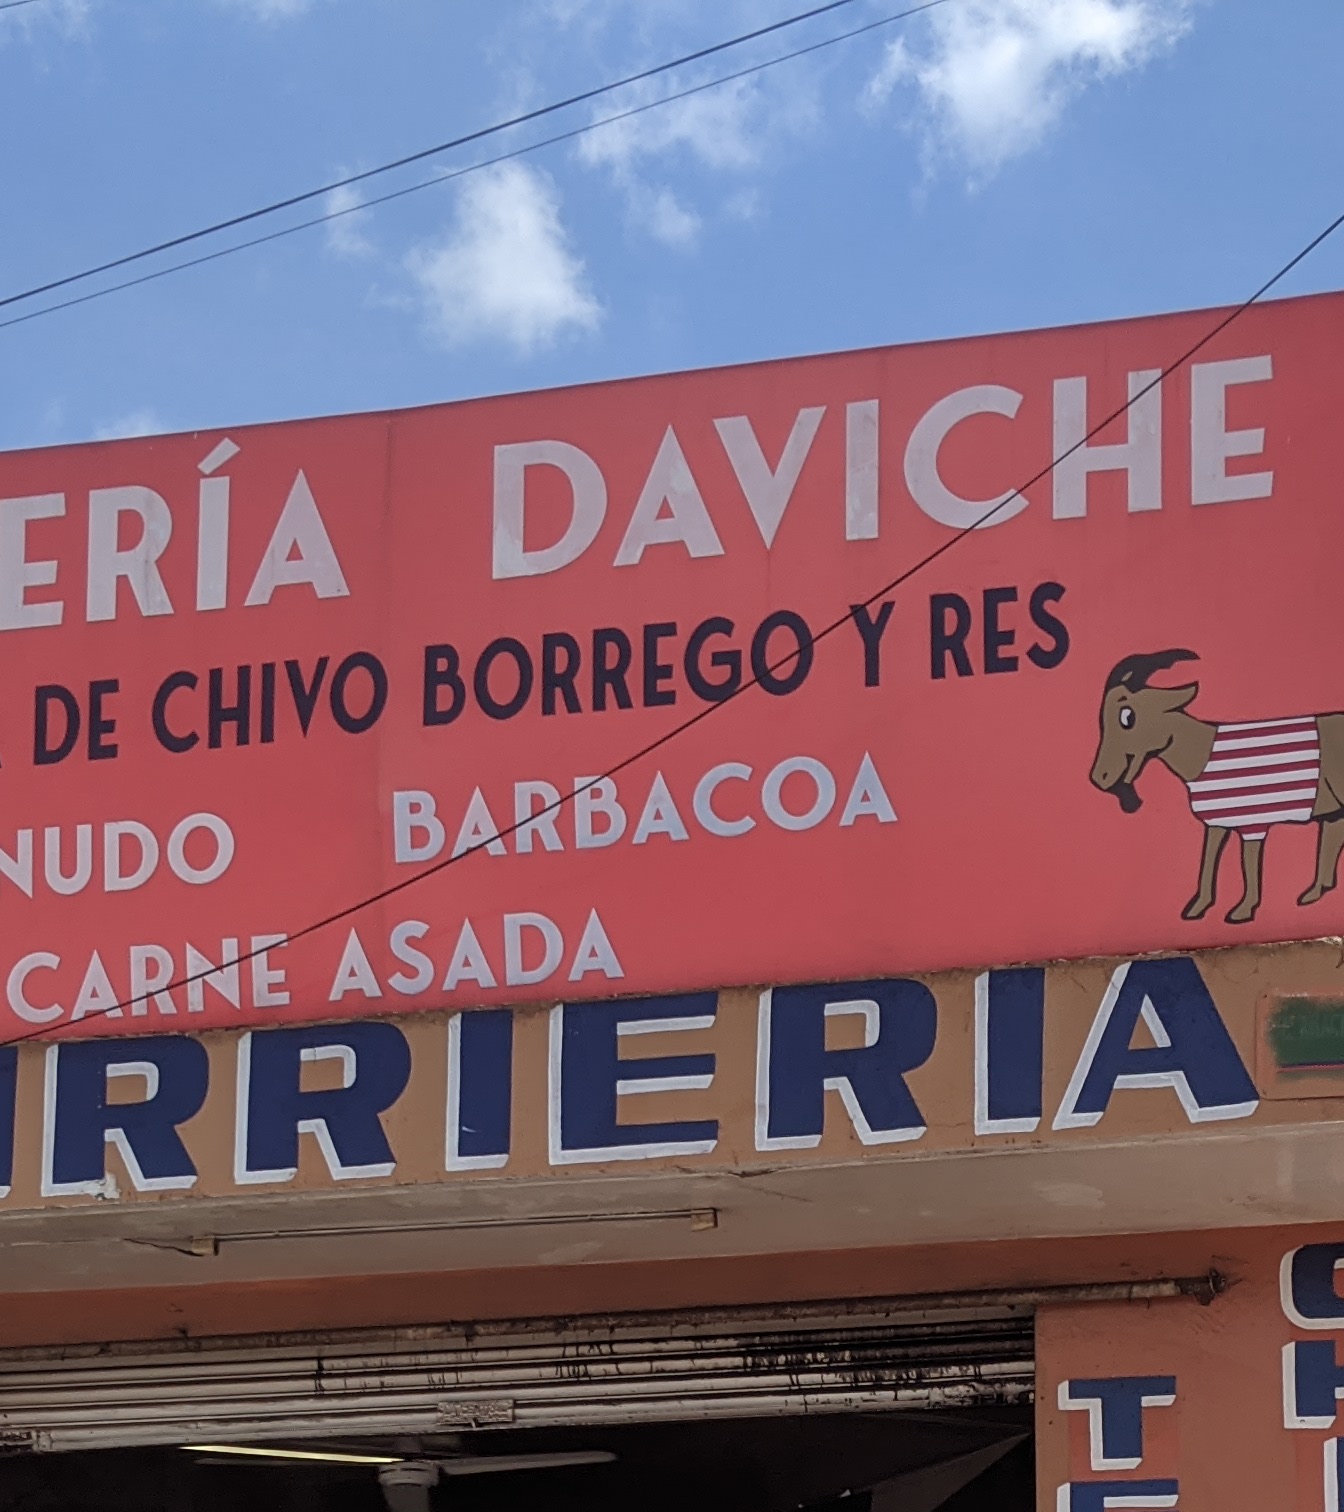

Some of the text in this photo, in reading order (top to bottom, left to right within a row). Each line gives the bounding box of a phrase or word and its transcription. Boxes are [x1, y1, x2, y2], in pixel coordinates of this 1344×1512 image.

[492, 355, 1273, 579] DAVICHE
[33, 679, 120, 765] DE
[152, 651, 388, 753] CHIVO
[423, 609, 814, 727] BORREGO
[849, 601, 896, 688] Y
[930, 581, 1071, 680] RES
[393, 751, 898, 863] BARBACOA
[6, 908, 624, 1024] CARNE ASADA
